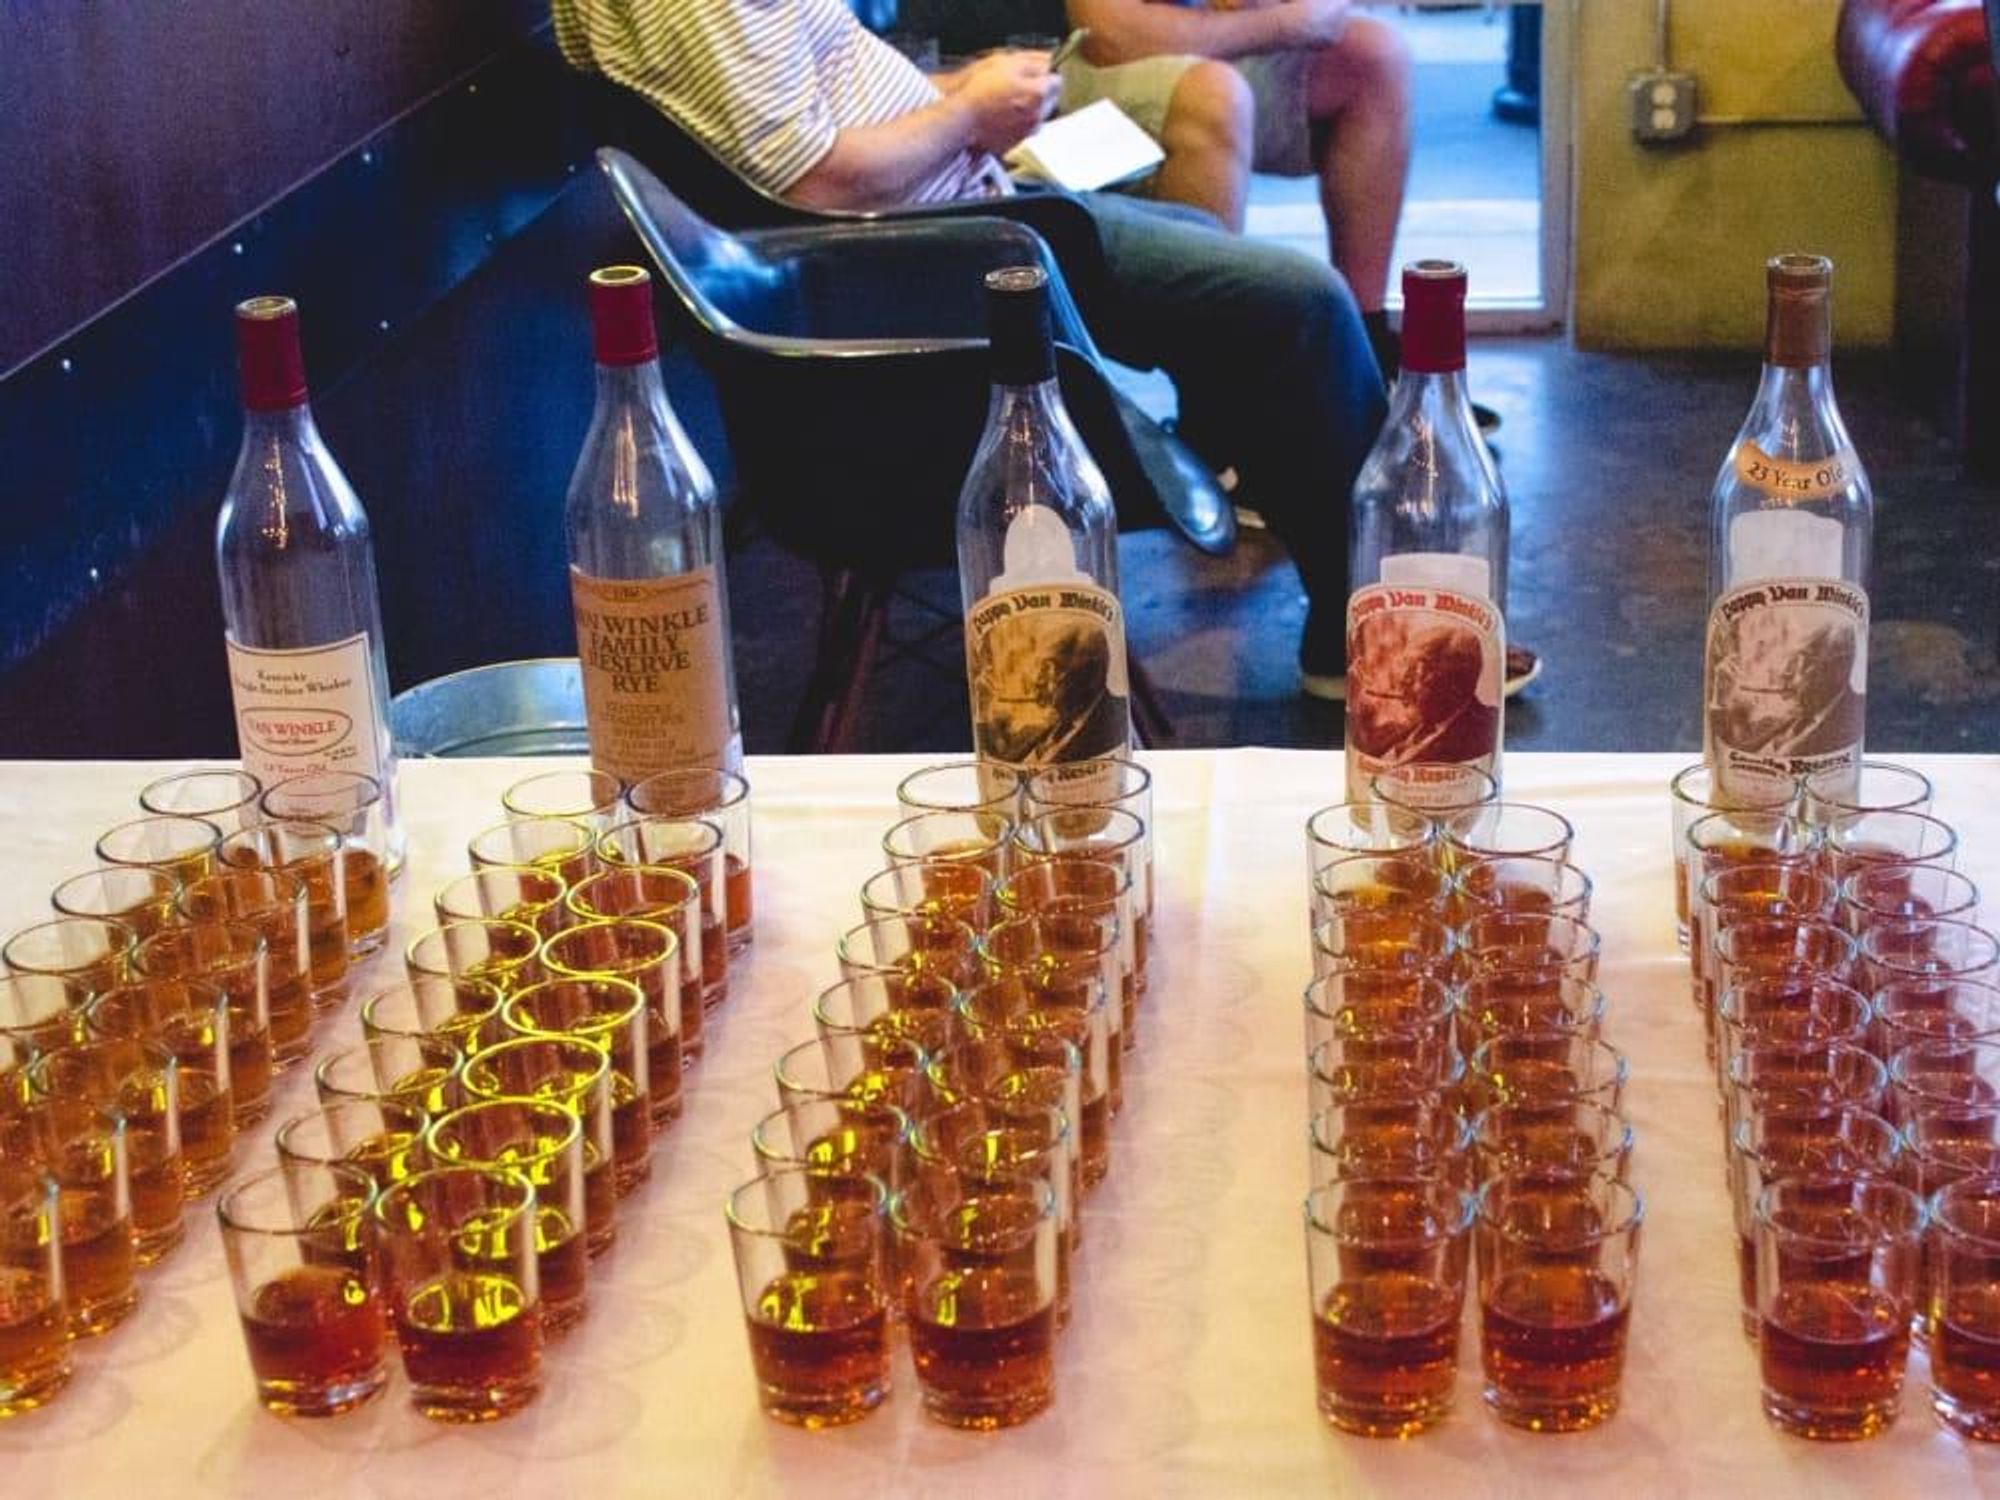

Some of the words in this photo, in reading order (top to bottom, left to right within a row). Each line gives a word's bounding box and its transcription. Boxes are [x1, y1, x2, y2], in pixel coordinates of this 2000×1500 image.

[1746, 461, 1769, 482] 23
[1775, 467, 1812, 490] Year
[1816, 463, 1843, 487] Old
[1011, 591, 1052, 611] Van
[1387, 591, 1426, 608] Van
[1767, 585, 1809, 602] Van
[602, 602, 709, 636] WINKLE
[592, 629, 679, 657] FAMILY
[612, 674, 658, 693] RYE
[273, 719, 337, 738] WINKLE
